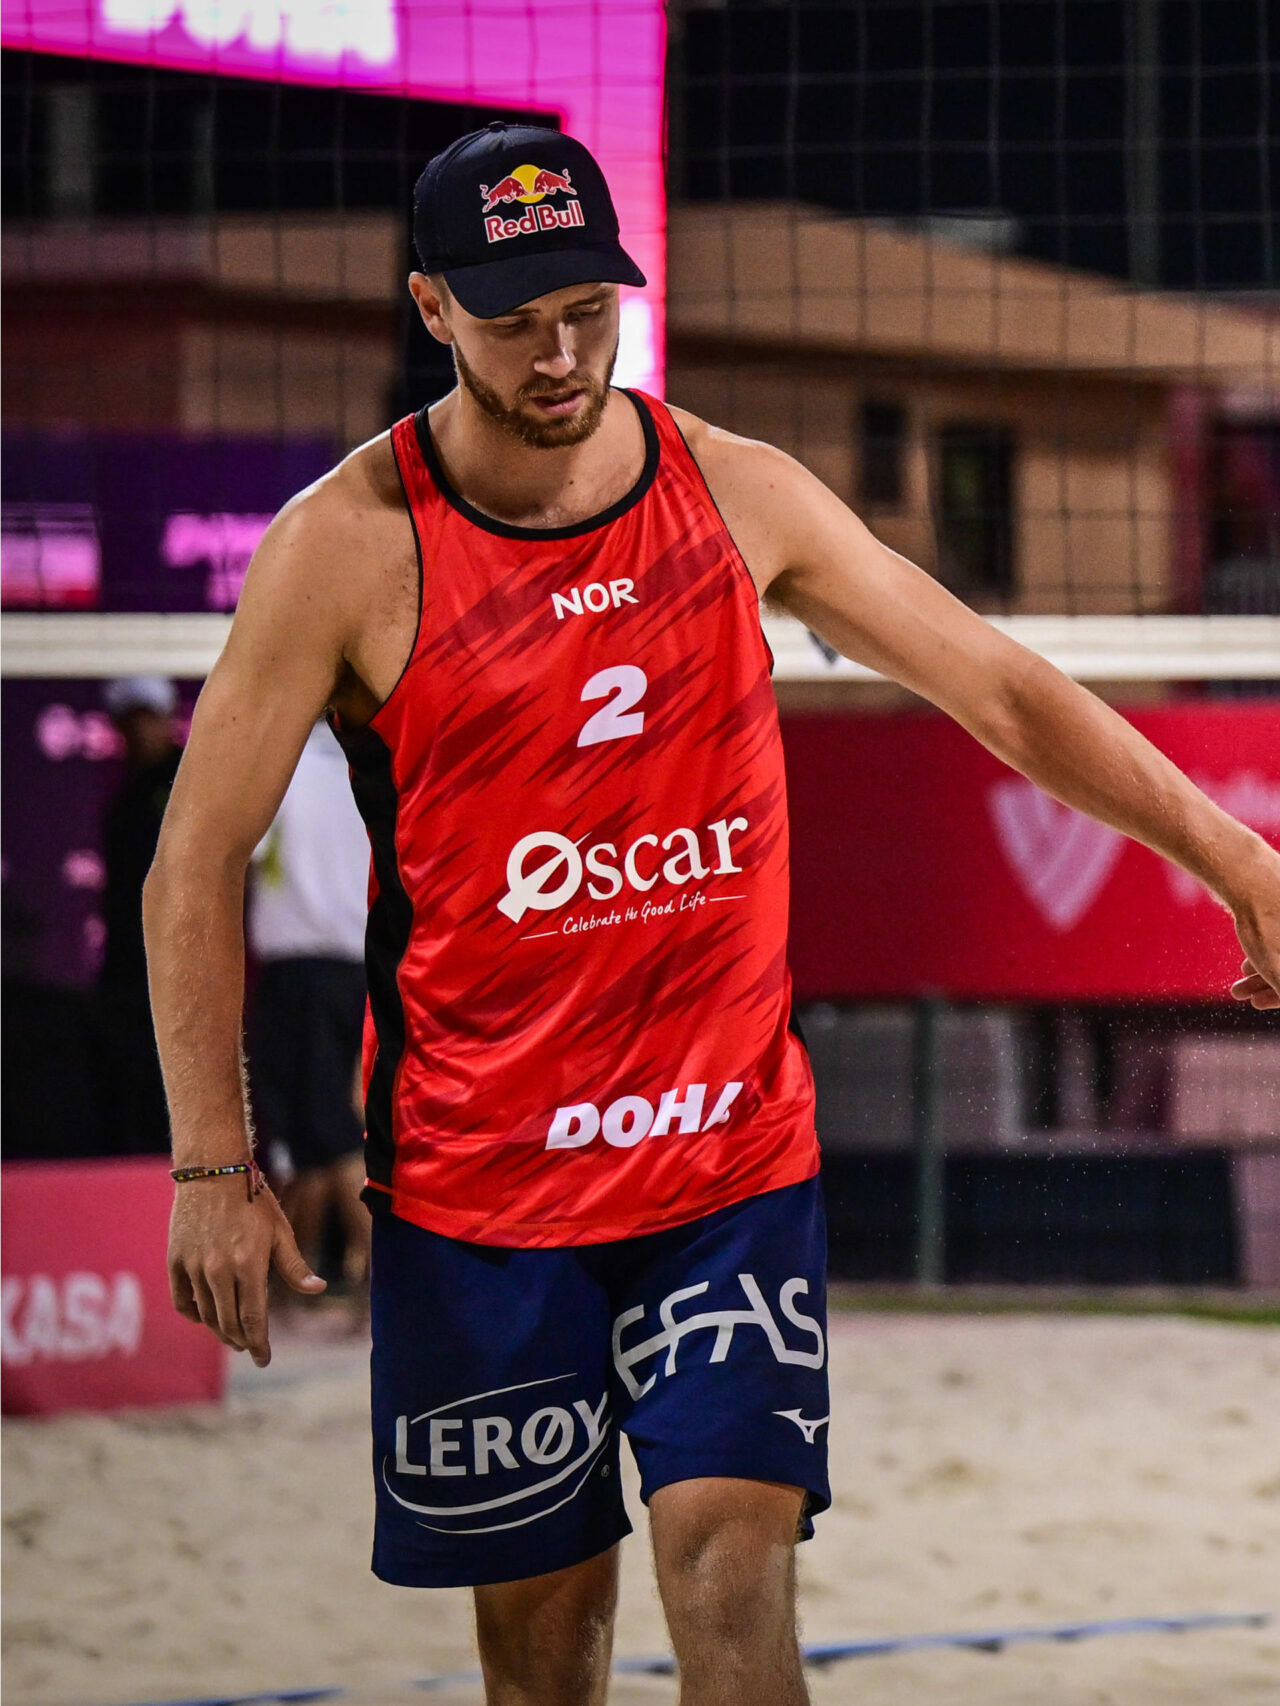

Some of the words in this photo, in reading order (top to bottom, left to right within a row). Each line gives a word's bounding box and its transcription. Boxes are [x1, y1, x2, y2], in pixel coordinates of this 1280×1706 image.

[484, 206, 539, 243] Red
[536, 200, 585, 230] Bull
[551, 577, 640, 620] NOR
[576, 664, 648, 748] 2
[562, 909, 622, 935] Celebrate
[641, 900, 676, 924] Good
[679, 891, 706, 912] Life
[396, 1391, 608, 1476] LERØY
